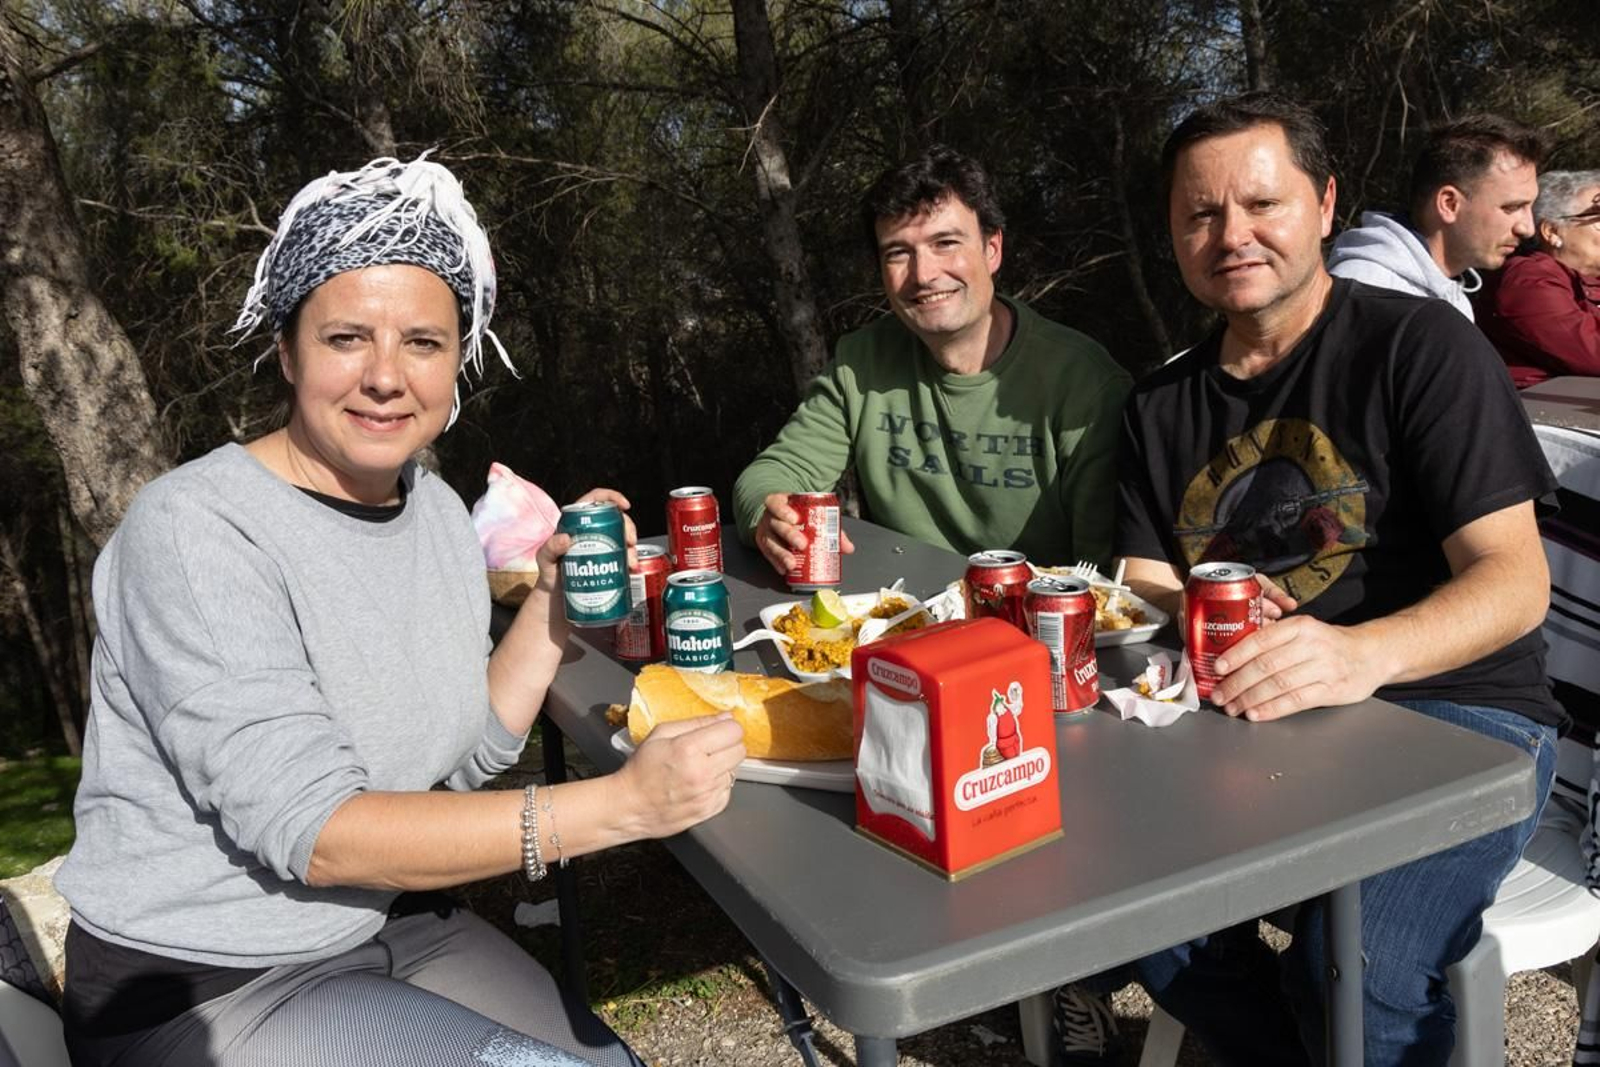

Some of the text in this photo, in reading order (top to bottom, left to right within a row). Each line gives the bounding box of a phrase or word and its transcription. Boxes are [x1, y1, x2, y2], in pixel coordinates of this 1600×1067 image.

[875, 411, 1046, 458] NORTH
[564, 560, 619, 577] Mahou
[1193, 618, 1246, 633] uzcampo
[668, 635, 722, 652] Mahou
[871, 662, 919, 691] Cruzcampo
[962, 756, 1046, 801] Cruzcampo
